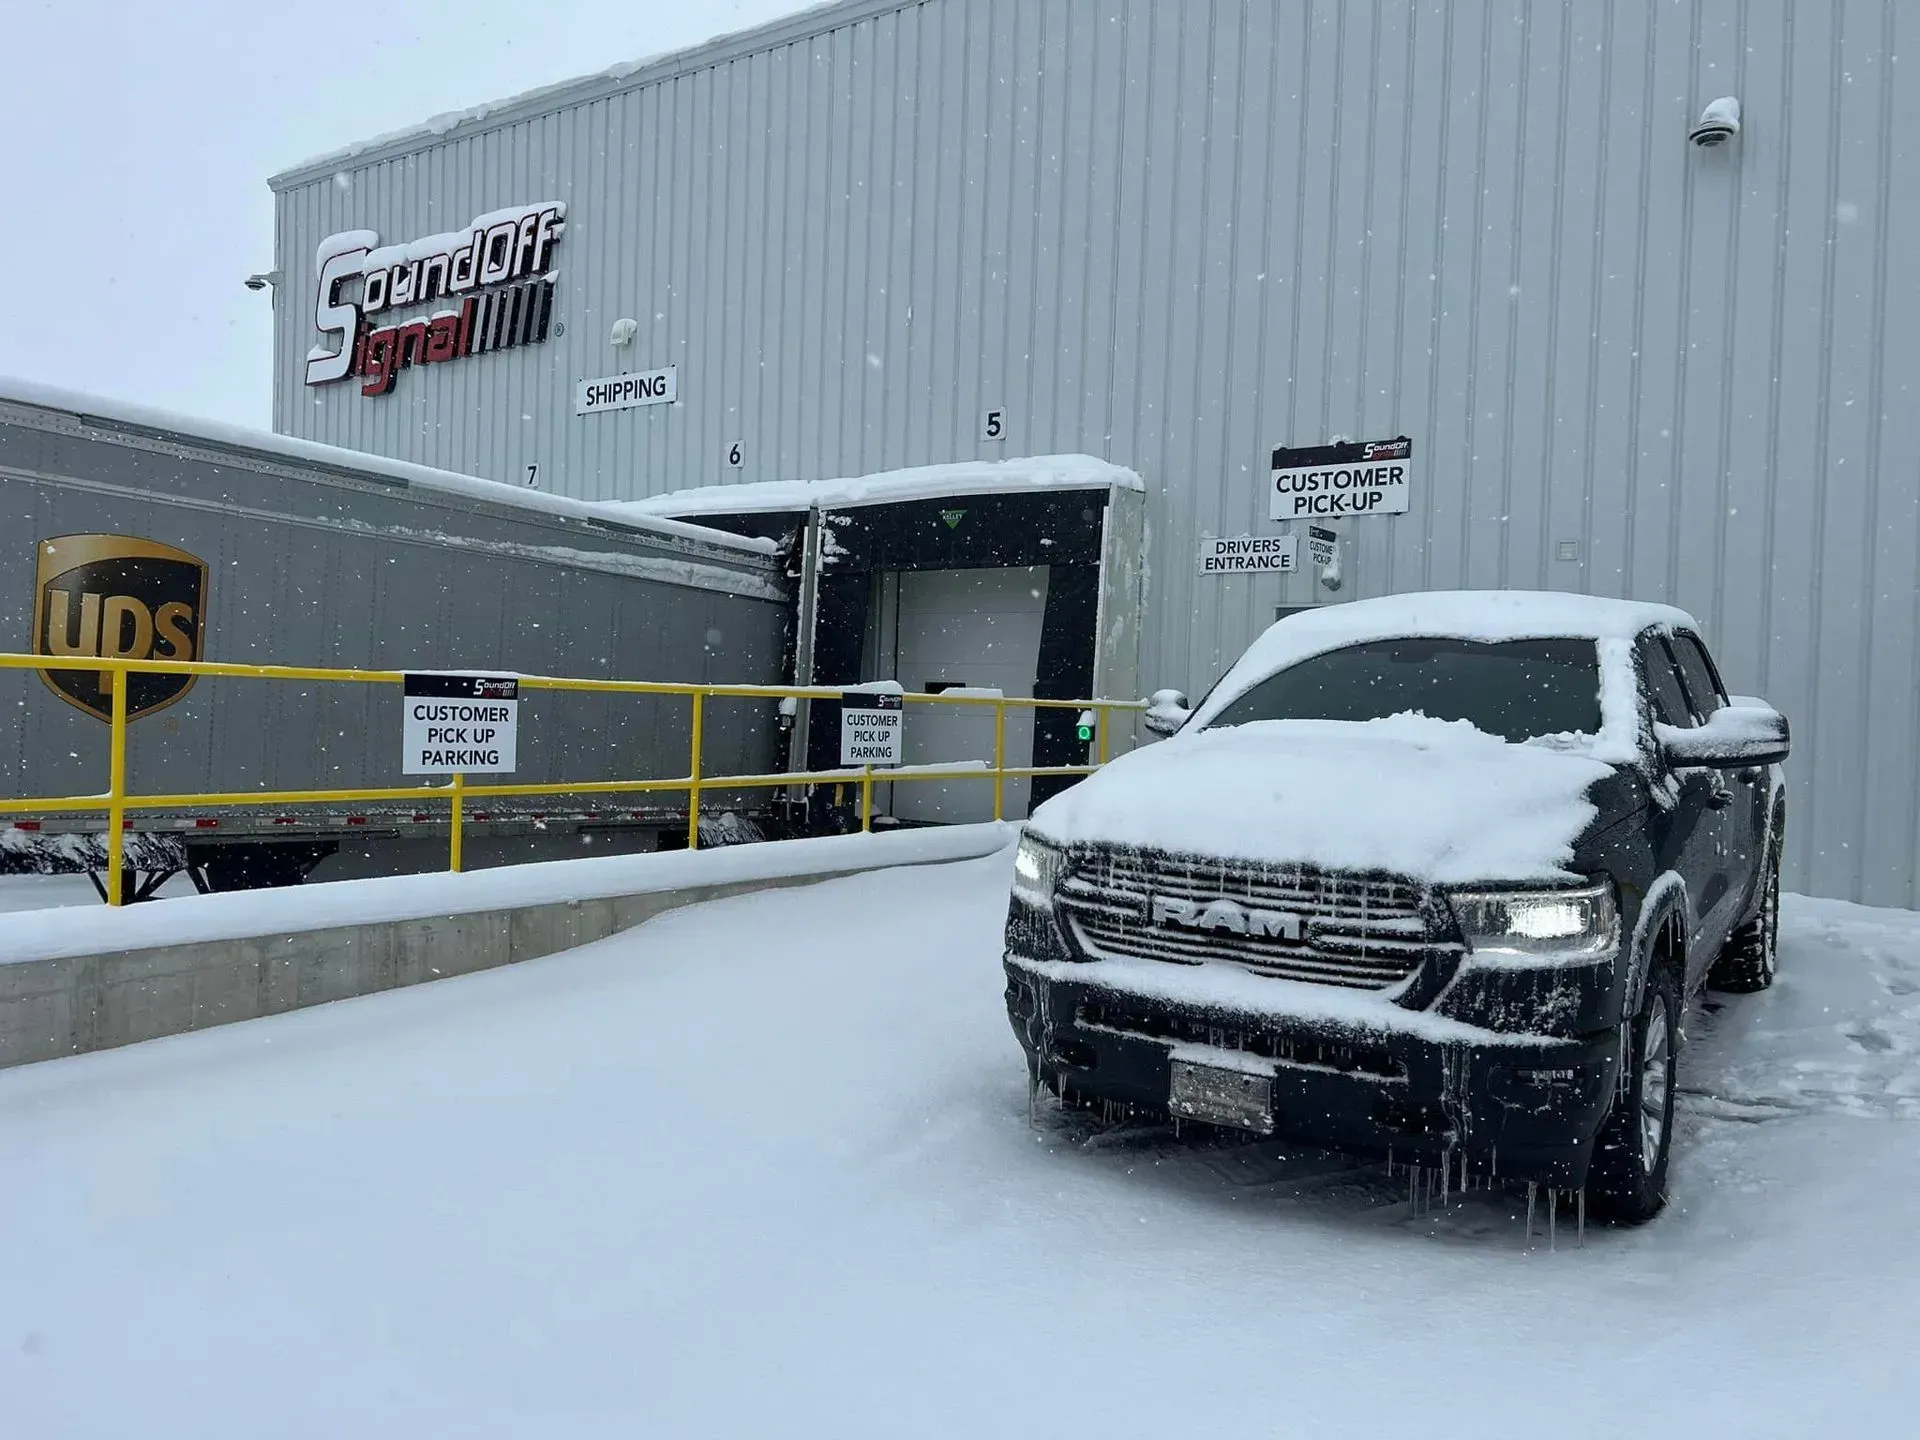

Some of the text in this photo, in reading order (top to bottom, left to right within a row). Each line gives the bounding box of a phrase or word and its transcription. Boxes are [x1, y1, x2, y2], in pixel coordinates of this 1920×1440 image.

[305, 207, 565, 386] SoundOff
[586, 375, 666, 406] SHIPPING
[986, 412, 1001, 437] 5
[729, 443, 741, 465] 6
[527, 465, 537, 485] 7
[1276, 466, 1404, 494] CUSTOMER
[1294, 491, 1383, 515] PICK-UP
[1216, 539, 1281, 554] DRIVERS
[1205, 554, 1290, 570] ENTRANCE
[413, 705, 509, 722] CUSTOMER
[846, 714, 898, 727] CUSTOMER
[473, 728, 495, 743] UP
[854, 731, 890, 742] PICK UP
[422, 750, 499, 766] PARKING
[850, 747, 892, 758] PARKING
[1152, 896, 1300, 941] RAM
